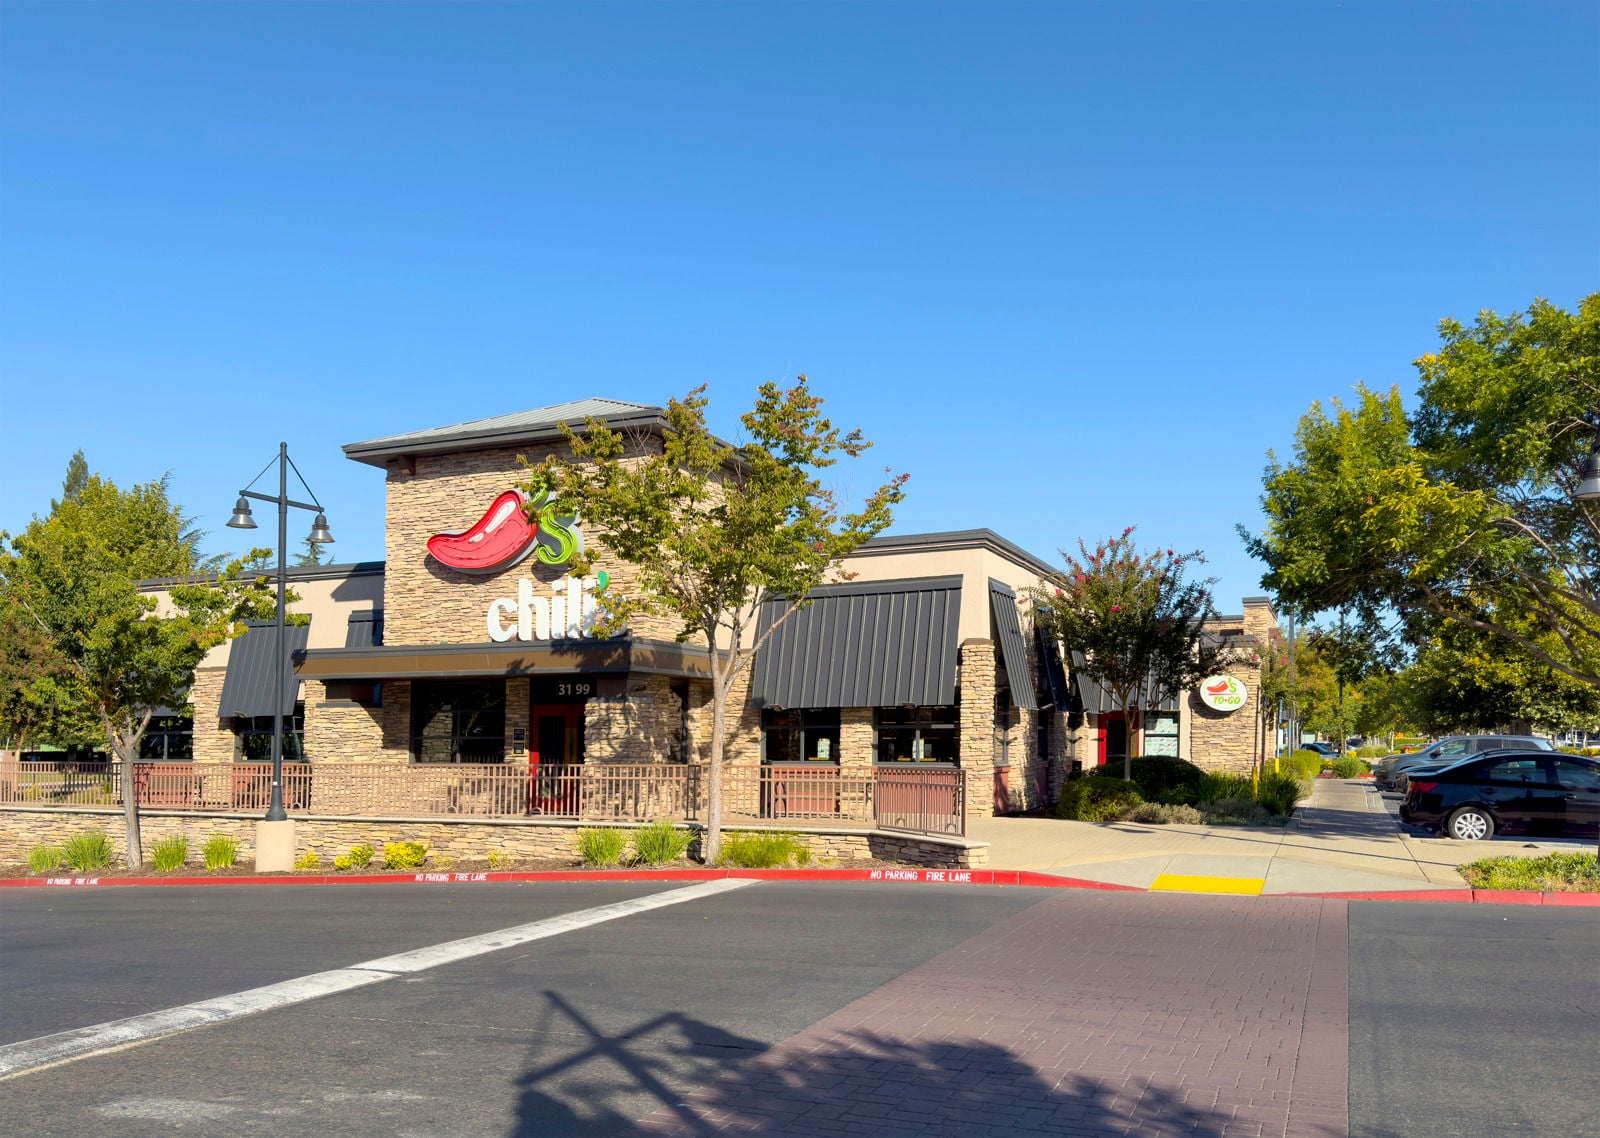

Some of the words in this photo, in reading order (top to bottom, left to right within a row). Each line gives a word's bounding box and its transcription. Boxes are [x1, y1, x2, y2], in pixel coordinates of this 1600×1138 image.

[415, 873, 424, 882] NO
[425, 873, 450, 882] PARKING
[454, 872, 469, 881] FIRE
[470, 872, 488, 881] LANE
[870, 870, 882, 880] NO
[884, 870, 918, 881] PARKING
[926, 871, 945, 882] FIRE
[949, 872, 972, 883] LANE
